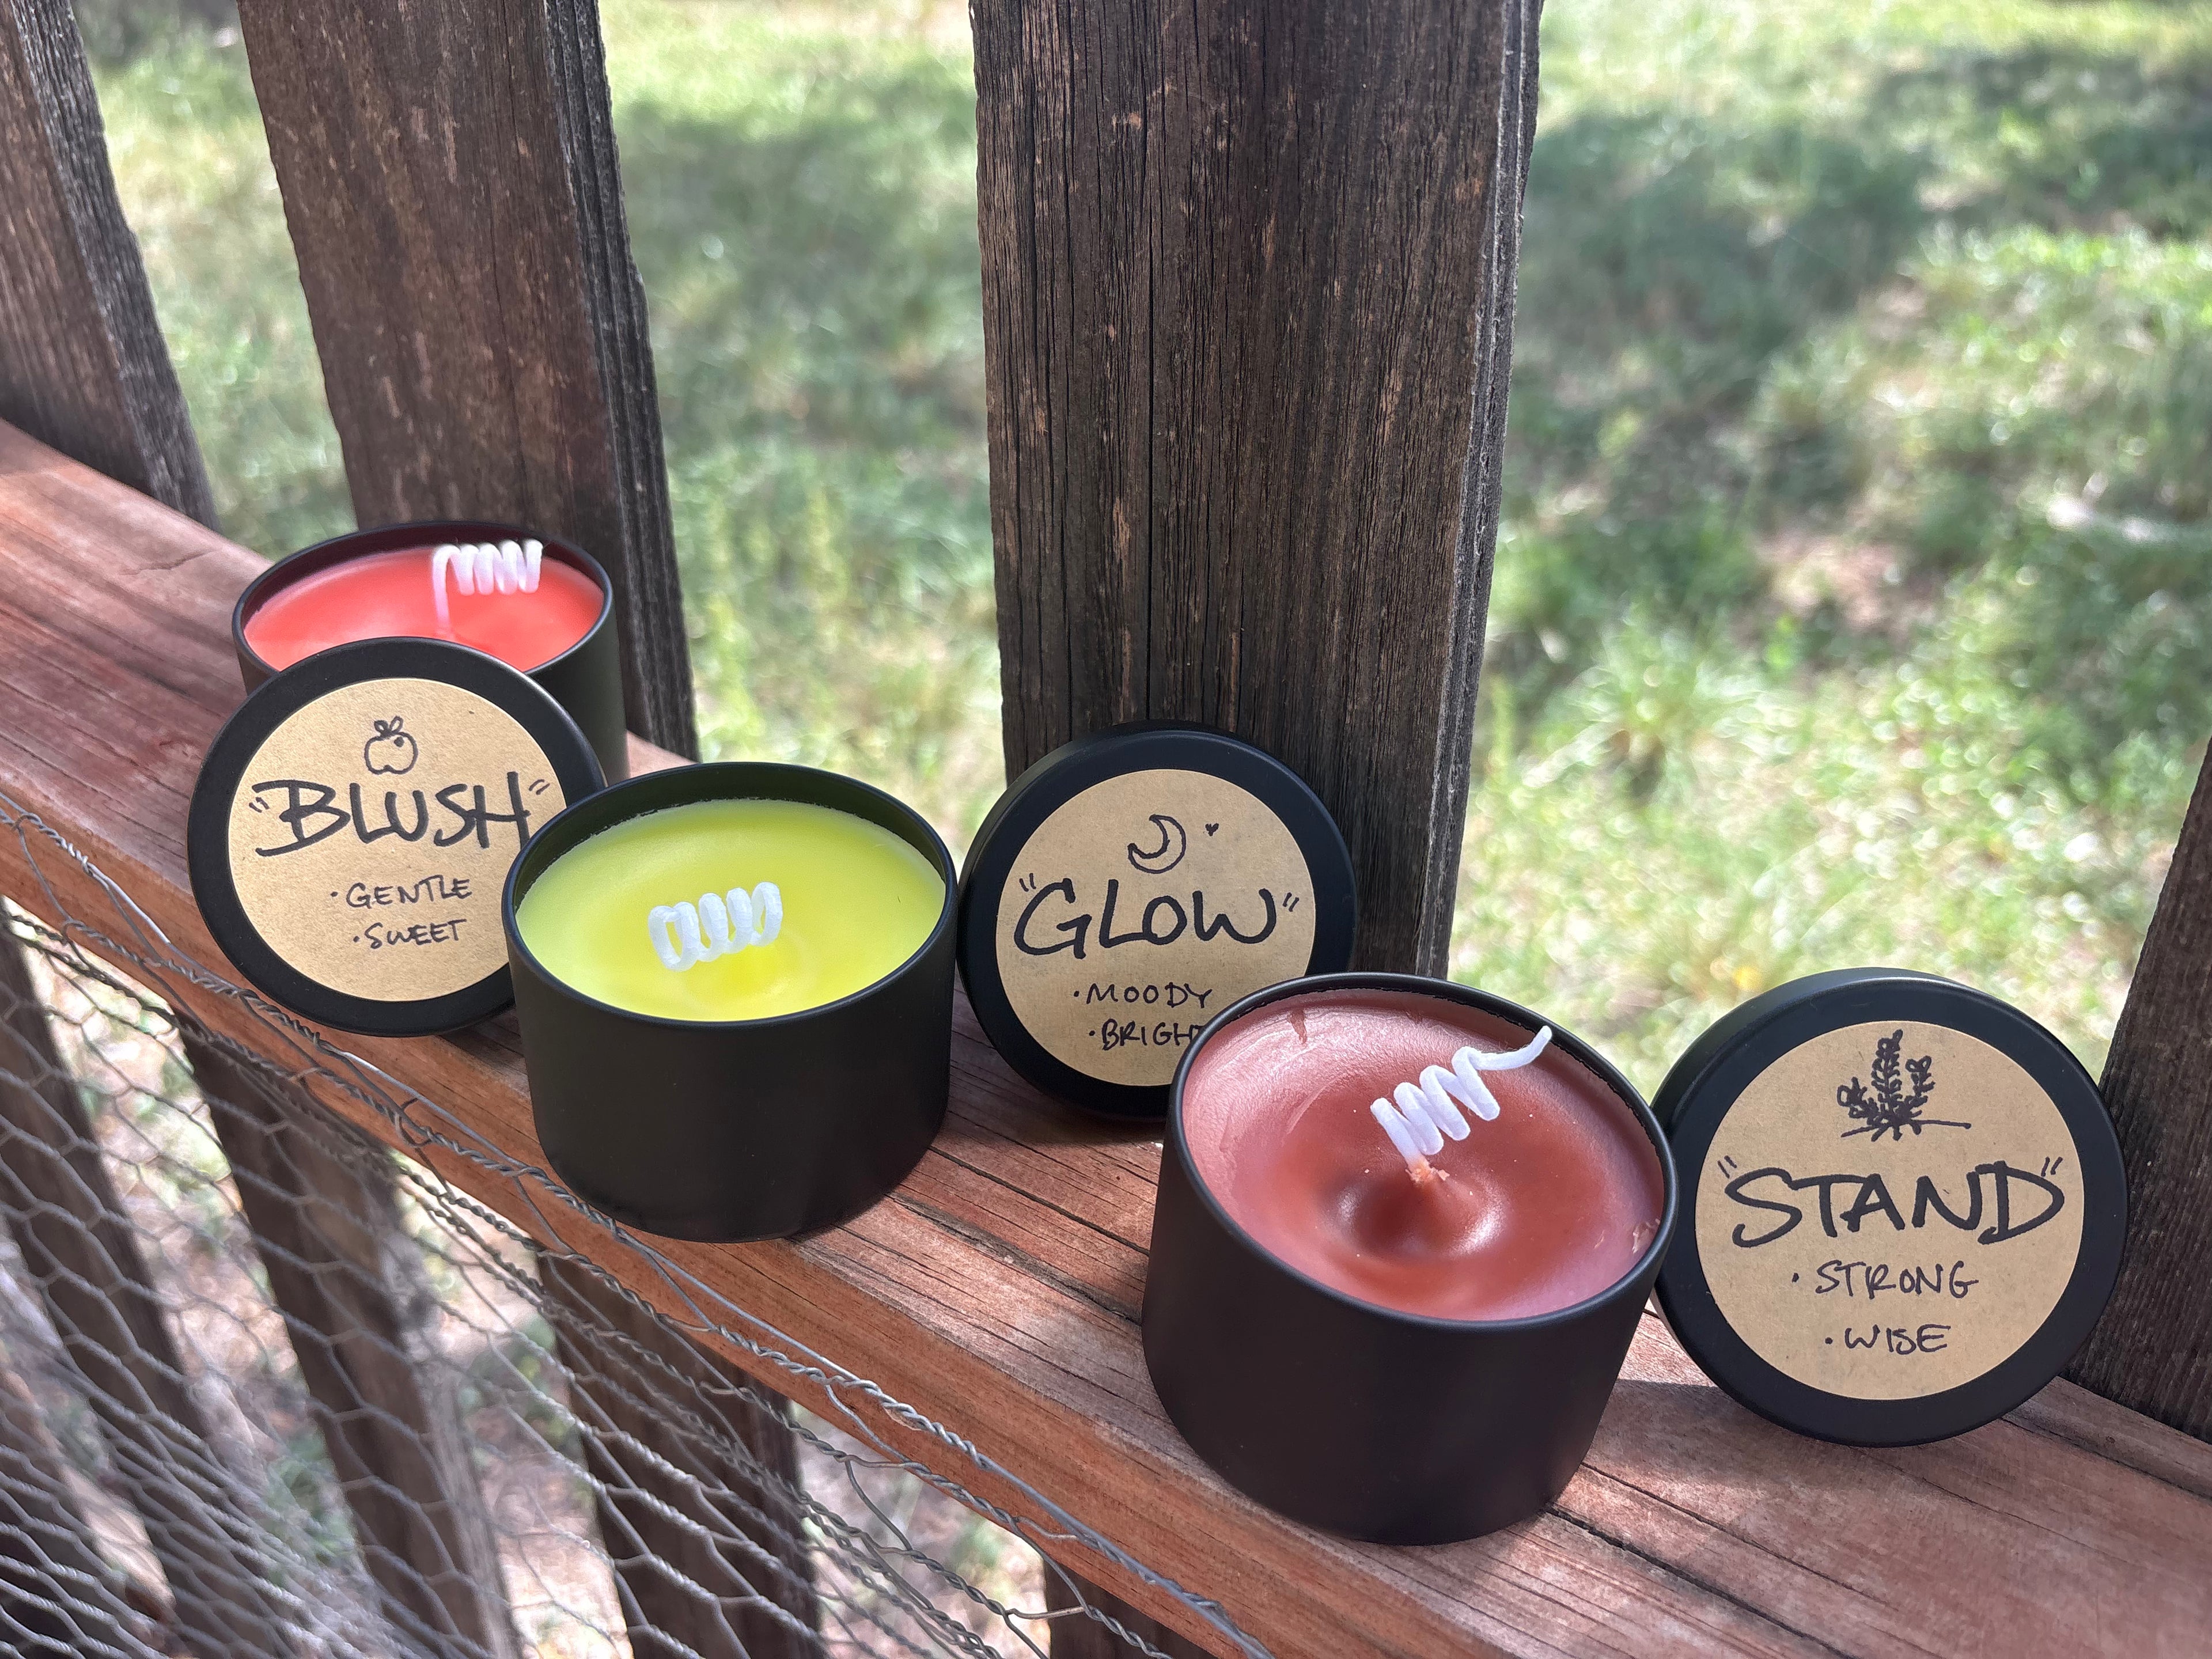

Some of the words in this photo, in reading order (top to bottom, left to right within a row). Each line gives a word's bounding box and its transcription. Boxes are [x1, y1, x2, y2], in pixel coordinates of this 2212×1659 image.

[248, 771, 550, 857] "BLUSH"
[346, 874, 472, 909] GENTLE
[1014, 873, 1299, 959] "GLOW"
[363, 919, 467, 950] SWEET
[1086, 982, 1212, 1009] MOODY
[1717, 1156, 2065, 1248] "STAND"
[1815, 1260, 1979, 1298] STRONG
[1844, 1324, 1951, 1355] WISE
